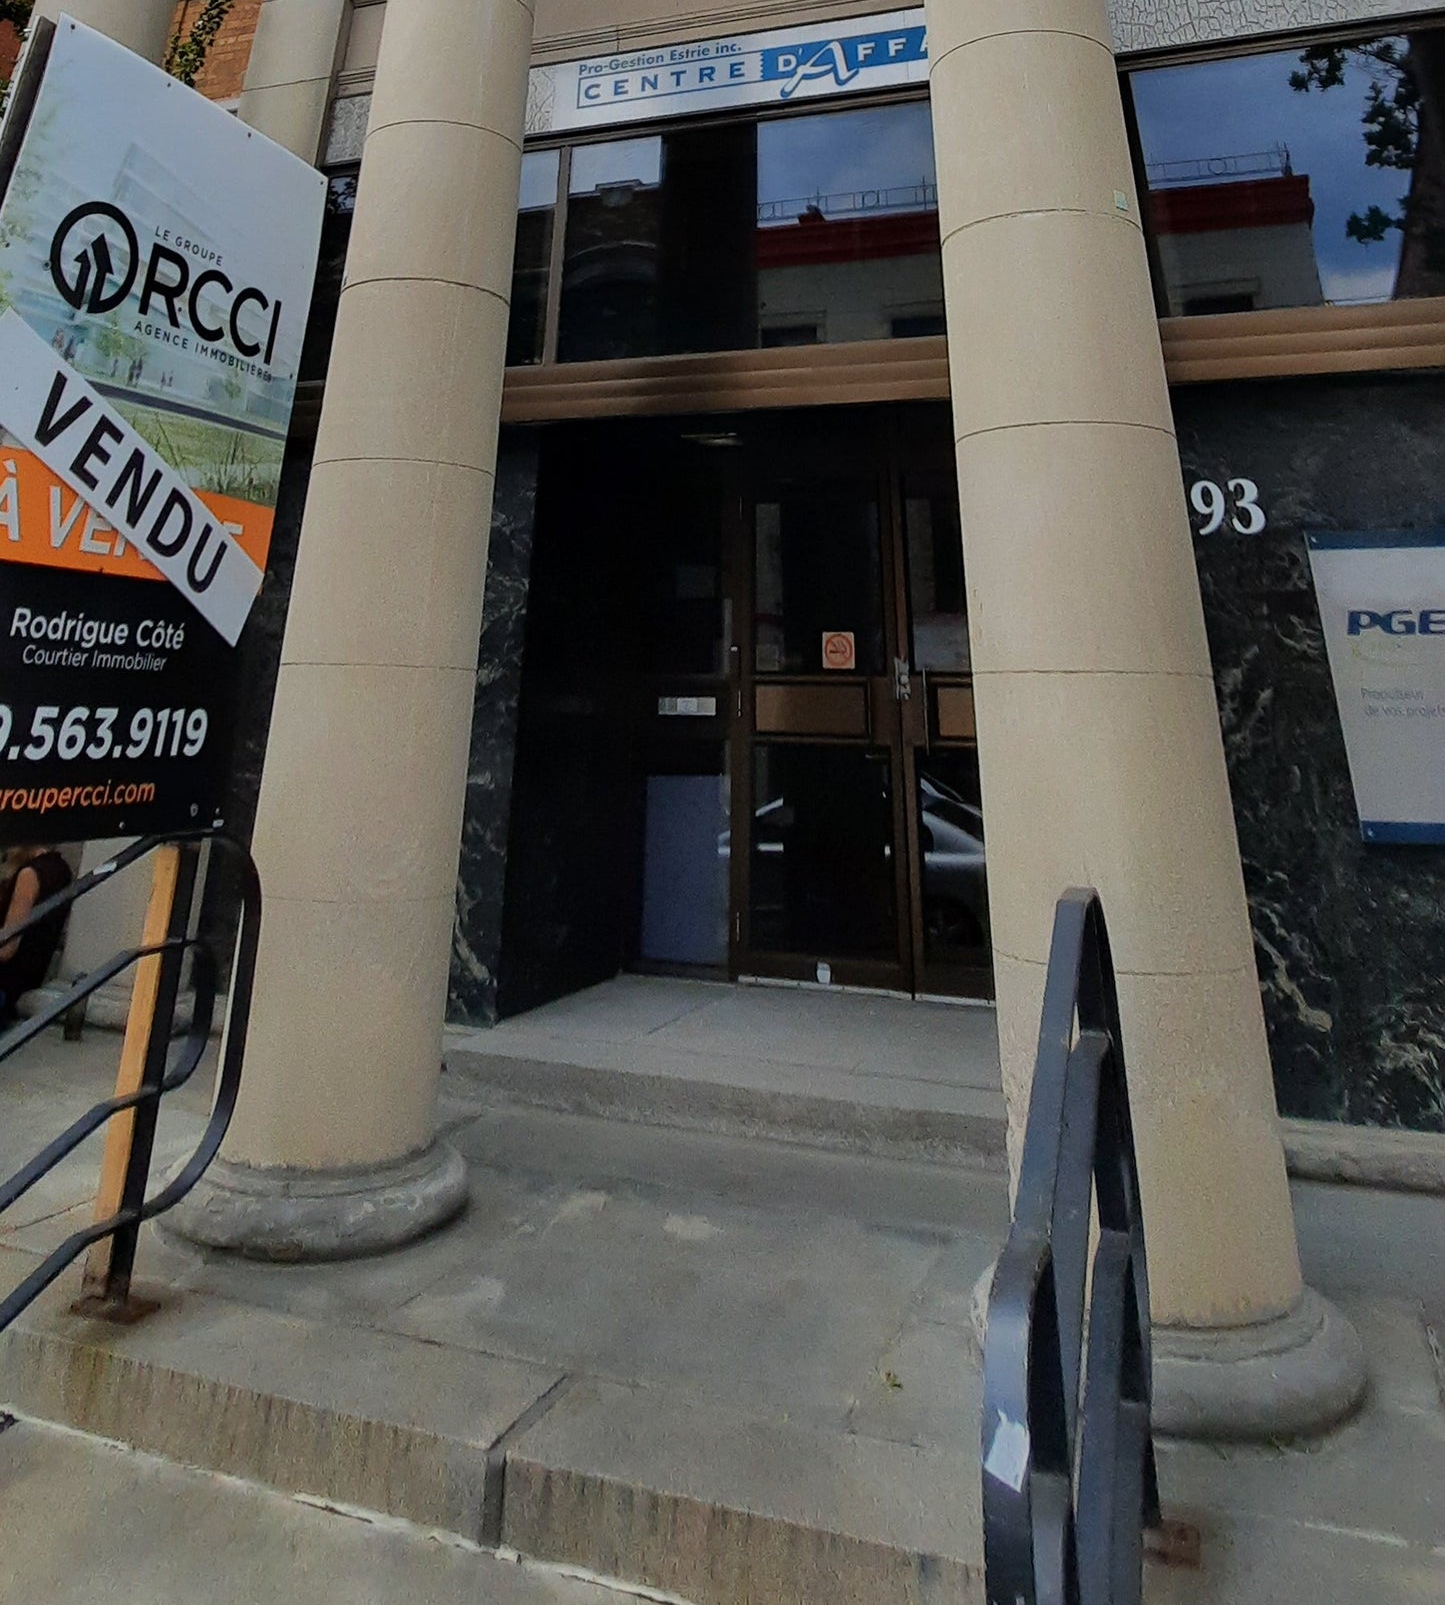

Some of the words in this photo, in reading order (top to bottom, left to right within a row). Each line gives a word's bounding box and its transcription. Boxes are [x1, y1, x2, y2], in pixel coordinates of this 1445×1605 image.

[578, 53, 665, 76] Pro-Gestion
[669, 45, 711, 62] Estrie
[715, 42, 742, 55] inc.
[584, 61, 746, 100] CENTRE
[155, 226, 171, 241] LE
[175, 236, 223, 266] GROUPE
[138, 242, 282, 366] RCCI
[134, 321, 189, 350] AGENCE
[35, 370, 228, 594] VENDU
[1190, 477, 1267, 536] 93
[10, 607, 129, 649] Rodrigue
[136, 620, 186, 650] Côté
[1347, 609, 1445, 636] PGE
[22, 644, 89, 667] Courtier
[92, 650, 168, 672] Immobilier
[0, 779, 156, 814] roupercci.com
